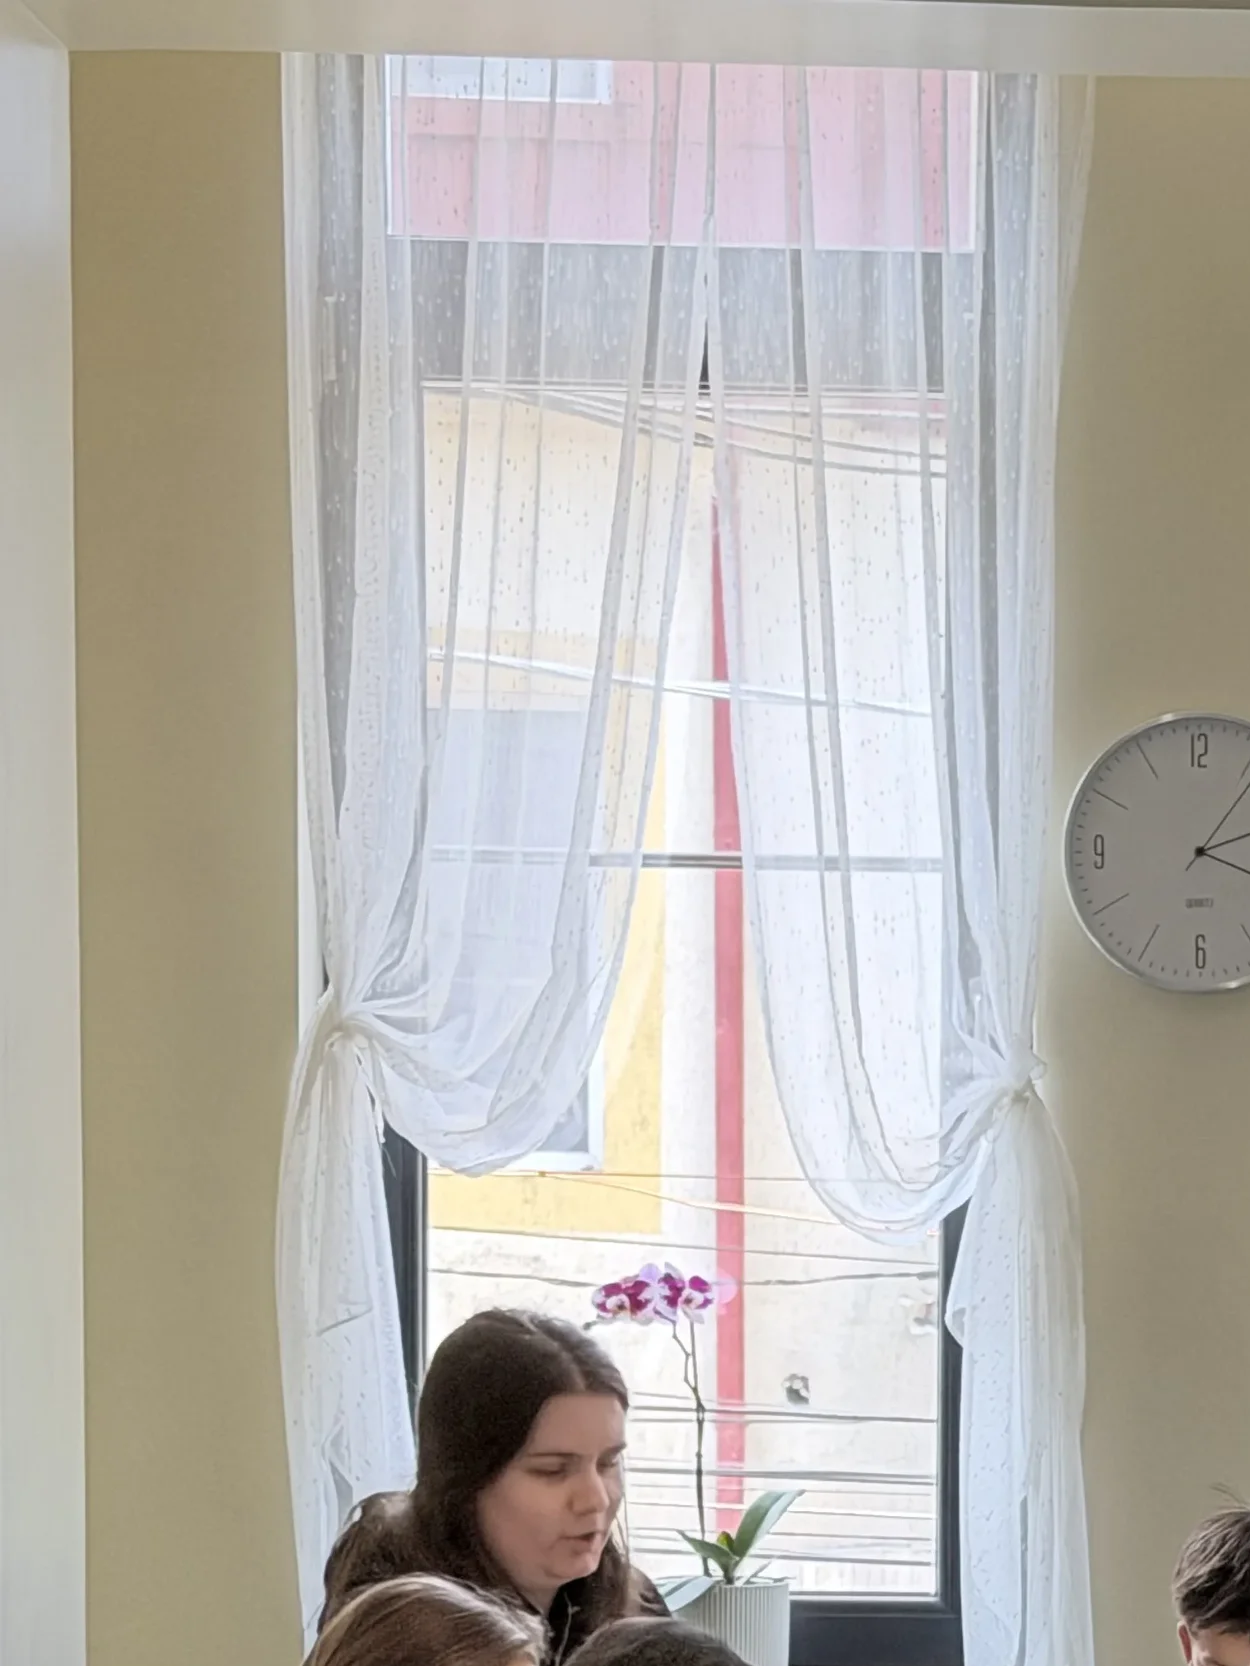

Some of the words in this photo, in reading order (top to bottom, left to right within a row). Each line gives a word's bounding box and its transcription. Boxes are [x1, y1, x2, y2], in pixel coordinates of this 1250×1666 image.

[1189, 732, 1208, 769] 12
[1092, 833, 1106, 870] 9
[1194, 933, 1207, 970] 6
